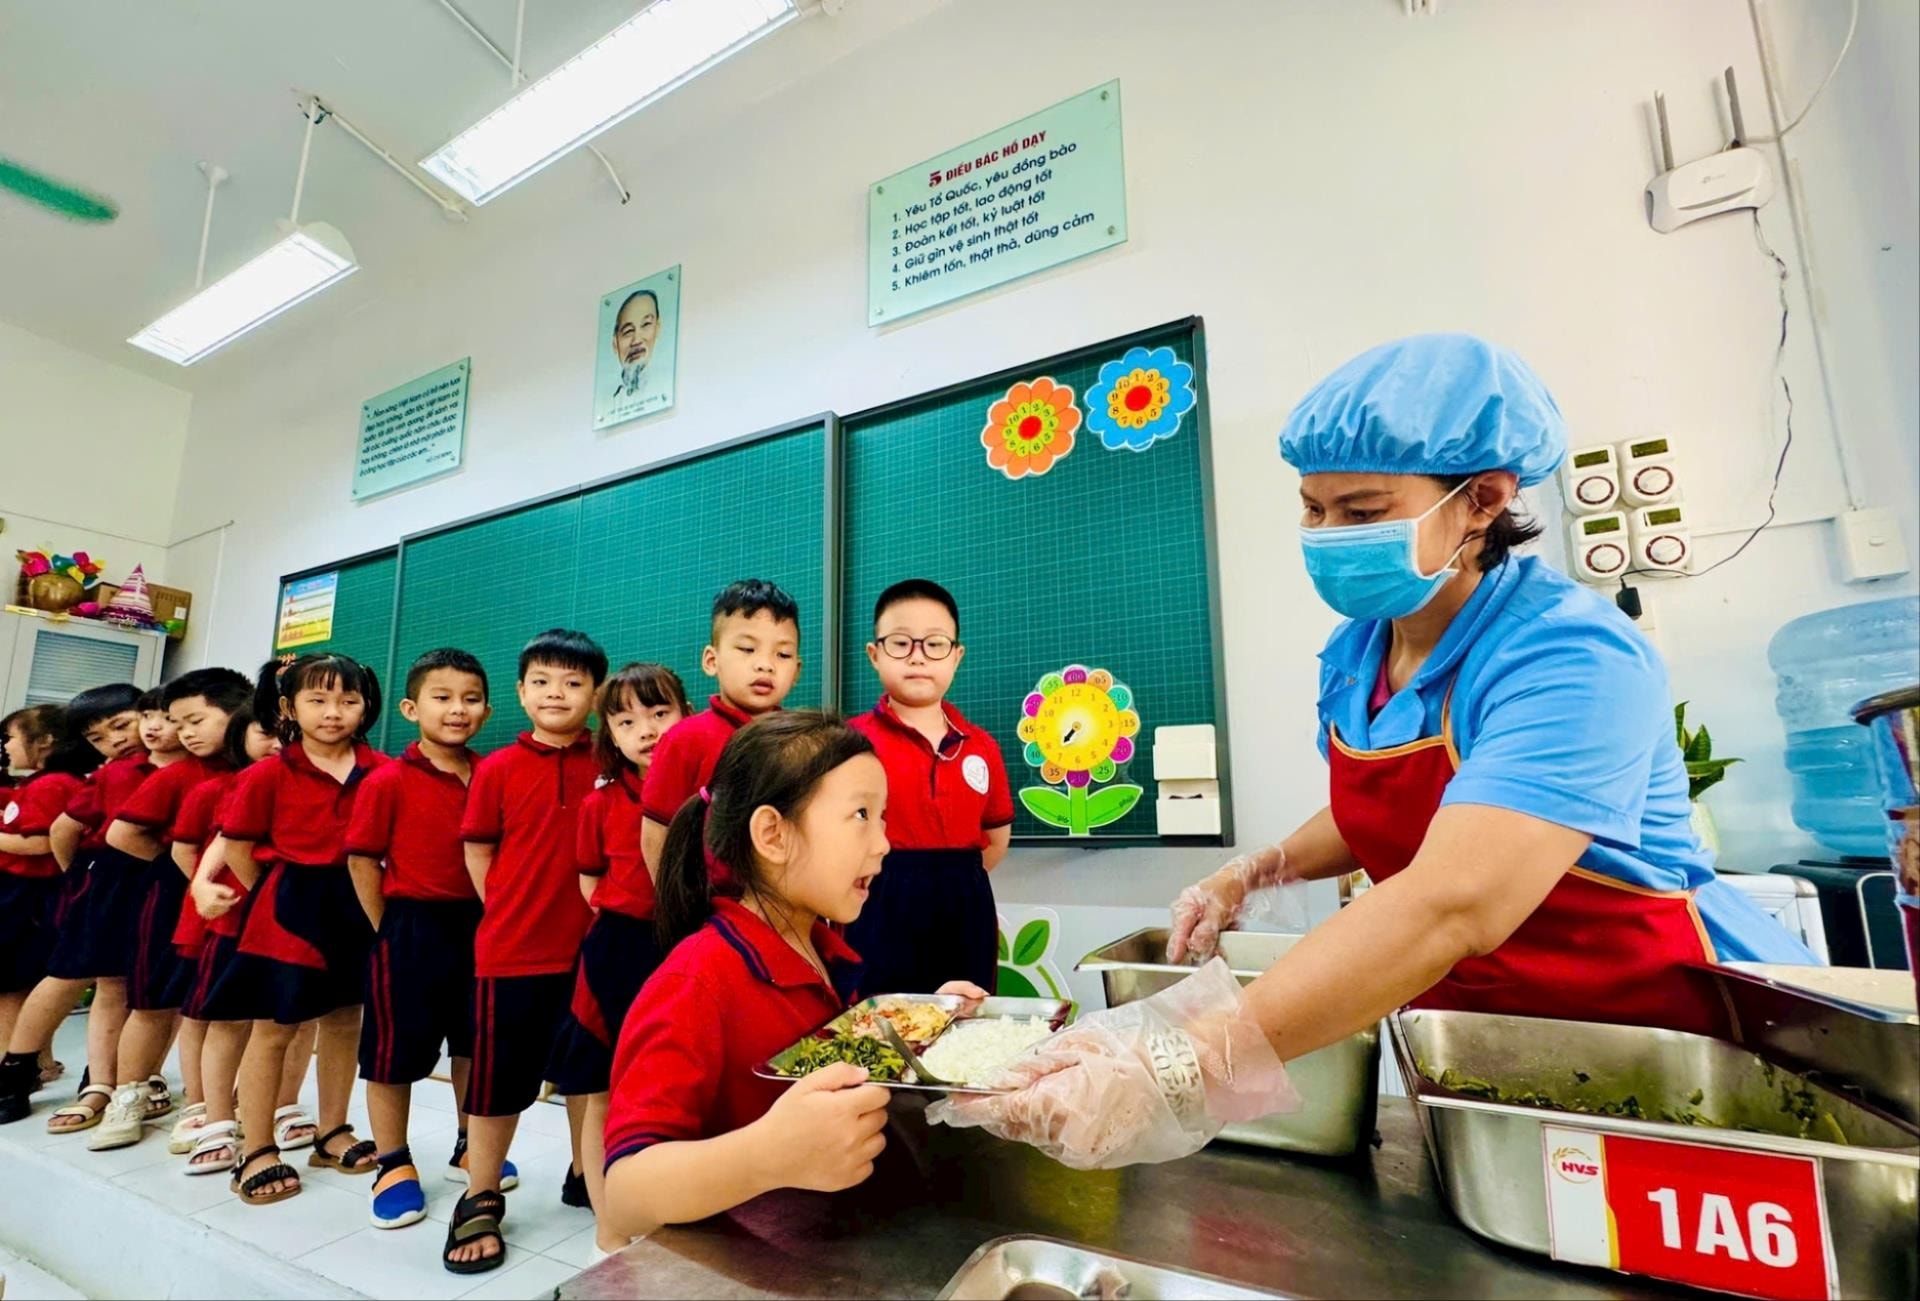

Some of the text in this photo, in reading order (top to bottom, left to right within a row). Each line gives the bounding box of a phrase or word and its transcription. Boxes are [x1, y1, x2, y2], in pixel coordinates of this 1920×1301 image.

[905, 203, 927, 217] Yêu
[929, 192, 943, 208] Tổ
[985, 170, 1009, 188] yêu
[1049, 142, 1077, 160] bào
[929, 170, 942, 187] 5
[975, 150, 999, 169] BÁC
[1022, 131, 1046, 149] DẠY
[905, 220, 928, 235] Học
[930, 211, 951, 225] tập
[975, 193, 996, 208] lao
[998, 179, 1032, 198] động
[1035, 168, 1052, 184] tốt
[905, 234, 936, 252] Đoàn
[939, 223, 958, 239] kết
[983, 207, 998, 223] kỷ
[1001, 198, 1025, 216] luật
[1028, 190, 1046, 206] tốt
[905, 268, 941, 287] Khiêm
[969, 246, 994, 263] thật
[1024, 226, 1060, 244] dũng
[1062, 213, 1095, 231] cảm
[928, 247, 946, 264] gìn
[949, 239, 964, 253] vệ
[967, 231, 991, 247] sinh
[994, 219, 1019, 237] thật
[1022, 211, 1040, 226] tốt
[1647, 1187, 1798, 1268] 1A6
